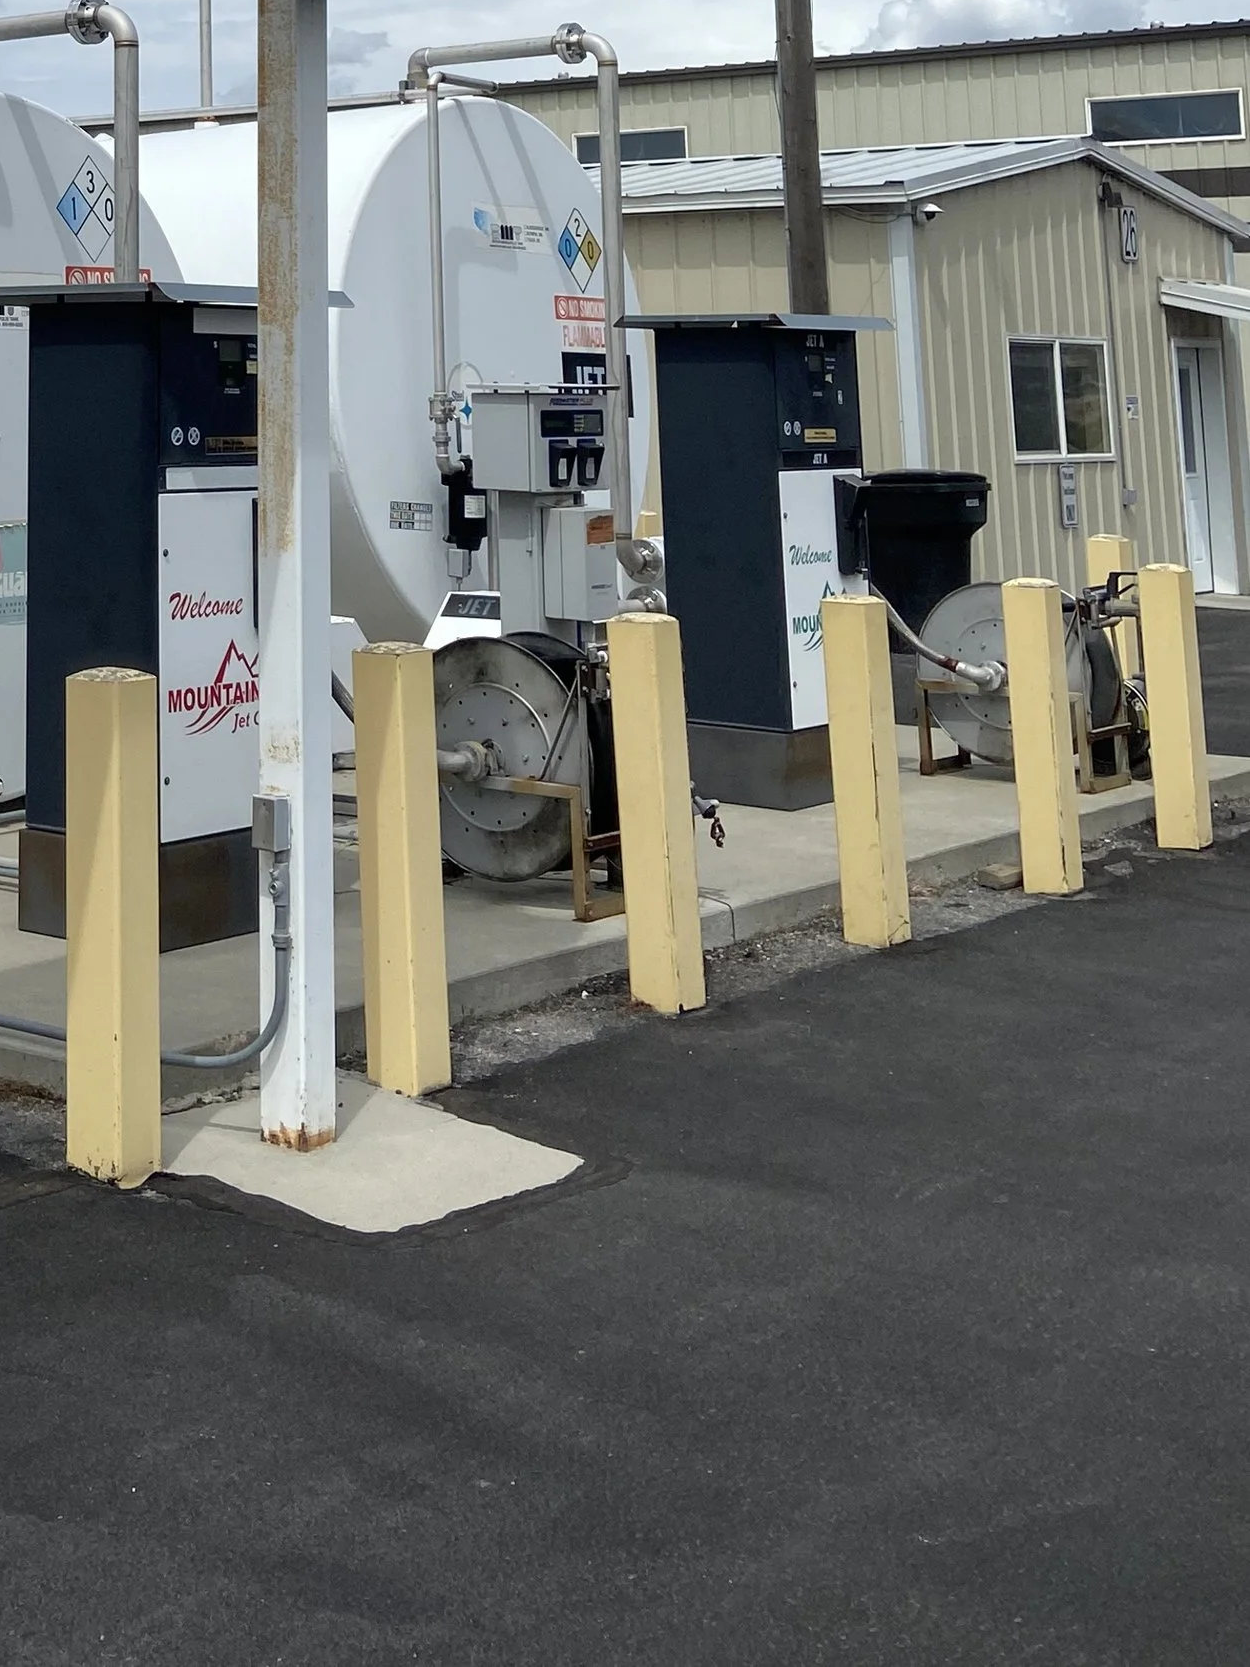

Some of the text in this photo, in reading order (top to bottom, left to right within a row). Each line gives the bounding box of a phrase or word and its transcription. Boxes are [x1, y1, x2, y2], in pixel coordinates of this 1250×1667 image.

[86, 170, 96, 194] 3
[71, 196, 77, 221] 1
[104, 197, 114, 222] 0
[574, 217, 582, 238] 2
[1122, 209, 1137, 258] 26
[564, 238, 572, 258] 0
[587, 240, 595, 260] 0
[568, 299, 579, 318] NO
[806, 334, 825, 349] JET A
[813, 453, 823, 465] JET
[788, 544, 833, 566] Welcome
[168, 590, 243, 621] Welcome
[458, 597, 497, 616] JET
[167, 679, 259, 713] MOUNTAIN
[231, 711, 250, 734] Jet
